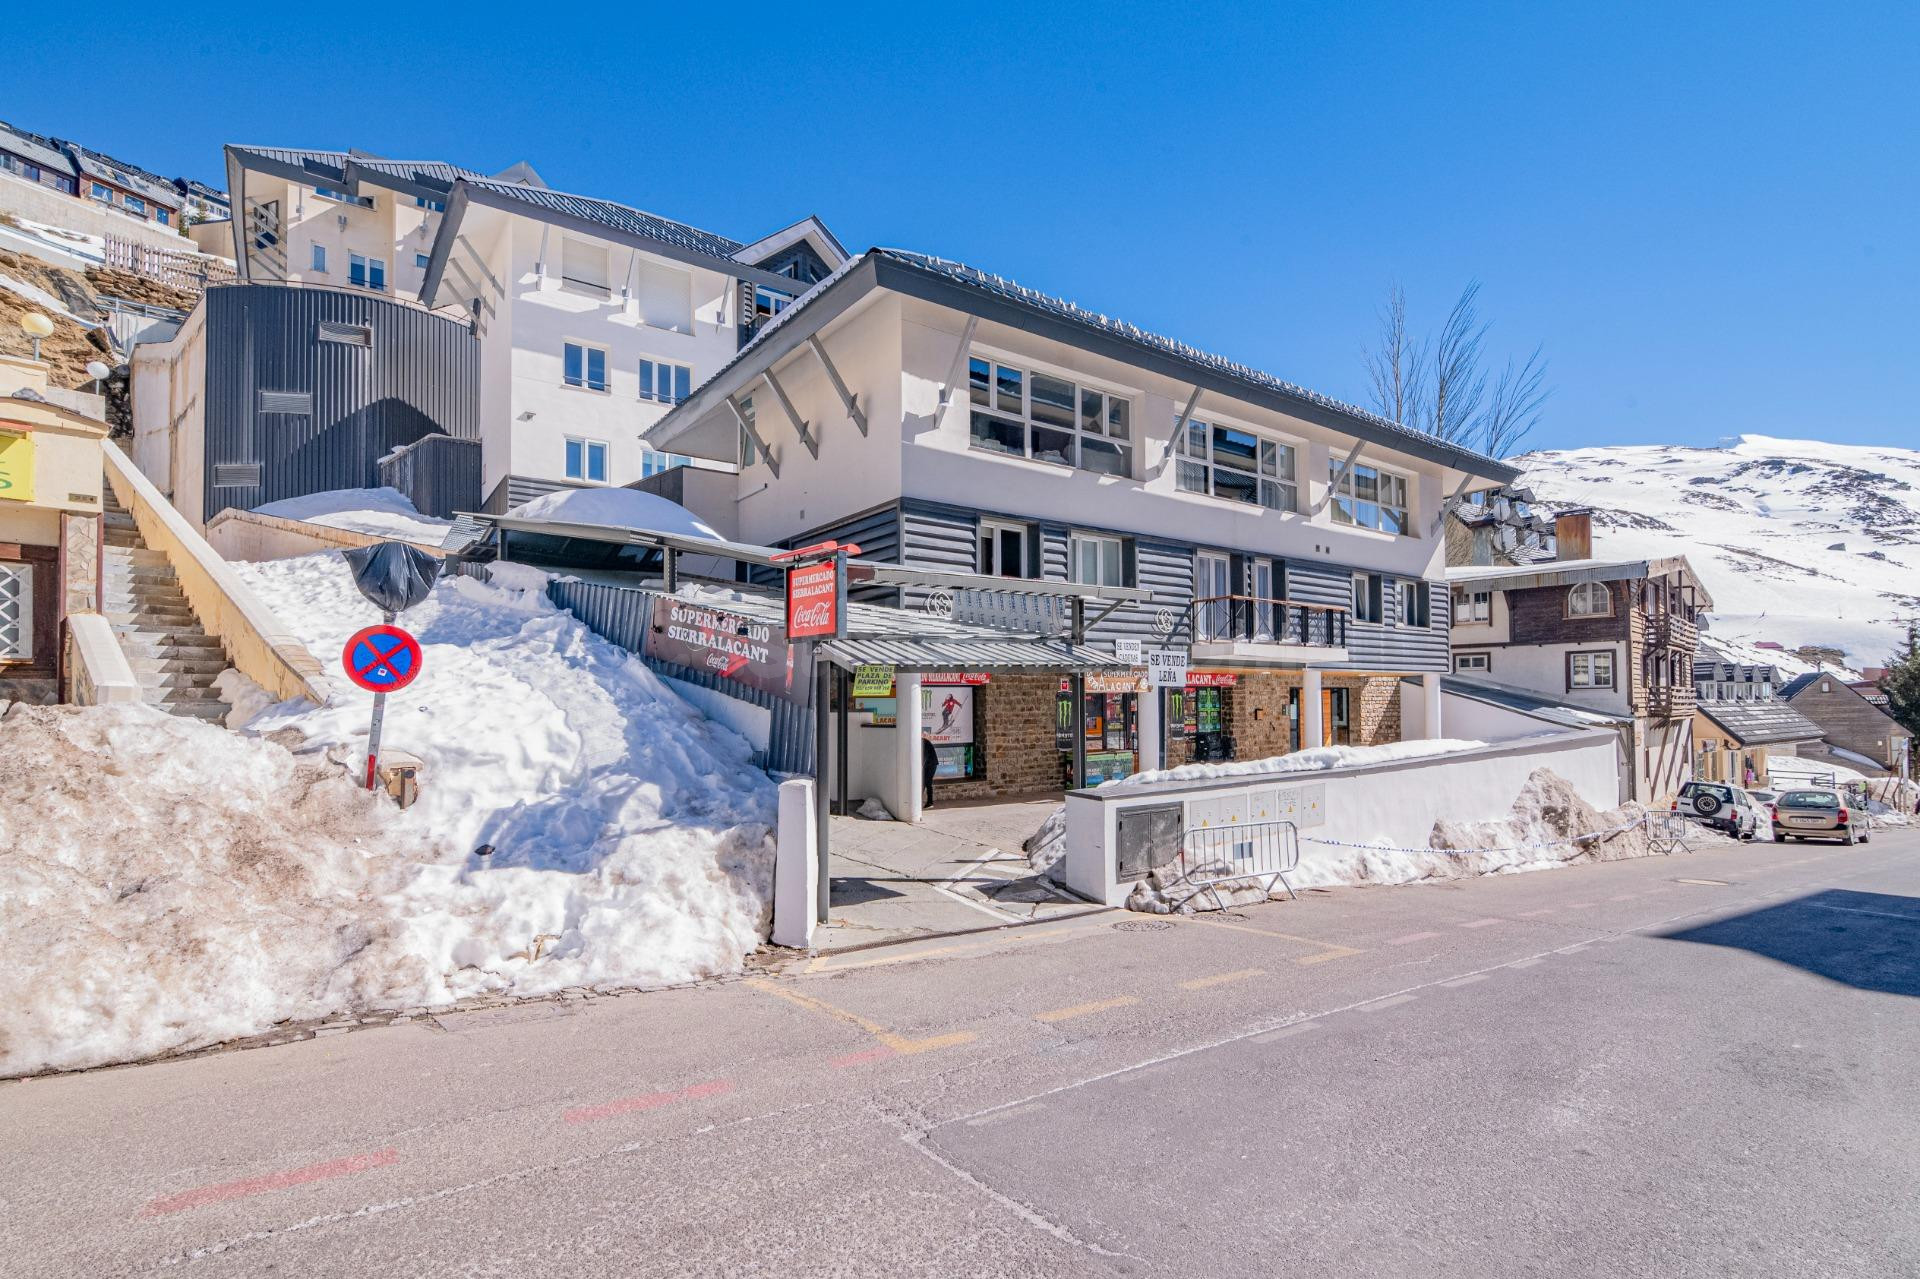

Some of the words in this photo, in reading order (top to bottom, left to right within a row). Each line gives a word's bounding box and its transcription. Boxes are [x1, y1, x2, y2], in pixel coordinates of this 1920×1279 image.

[792, 582, 834, 599] SIERRALACANT
[667, 625, 769, 664] SIERRALACANT
[1150, 654, 1160, 666] SE
[1162, 655, 1185, 667] VENDE
[1159, 668, 1177, 682] LEÑA
[1186, 674, 1212, 684] LACANT
